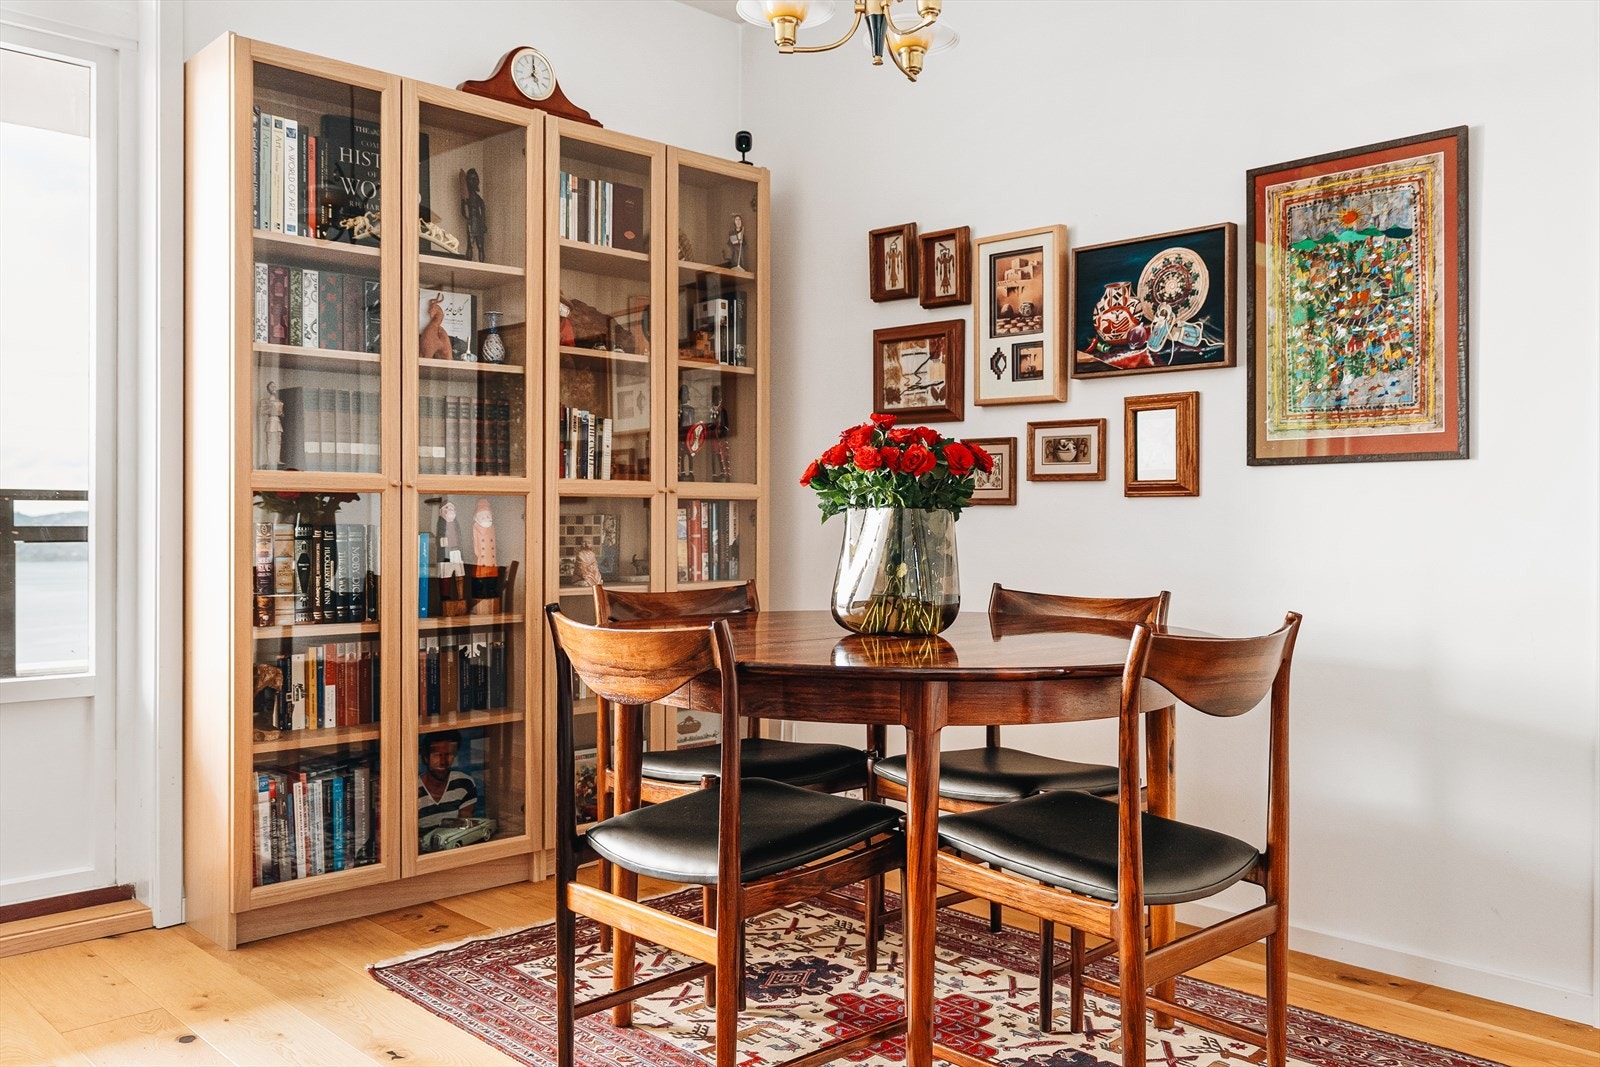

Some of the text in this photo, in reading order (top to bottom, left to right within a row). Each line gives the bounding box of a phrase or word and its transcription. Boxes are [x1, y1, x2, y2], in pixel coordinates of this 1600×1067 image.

[354, 125, 368, 134] THE
[275, 135, 283, 149] Art
[361, 140, 380, 149] COM
[339, 147, 380, 169] HIST
[288, 154, 296, 183] WORLD
[288, 184, 296, 195] OF
[340, 177, 380, 199] WO
[287, 196, 296, 212] ART
[349, 200, 380, 211] RICHAR
[351, 546, 360, 600] MOBY DICK
